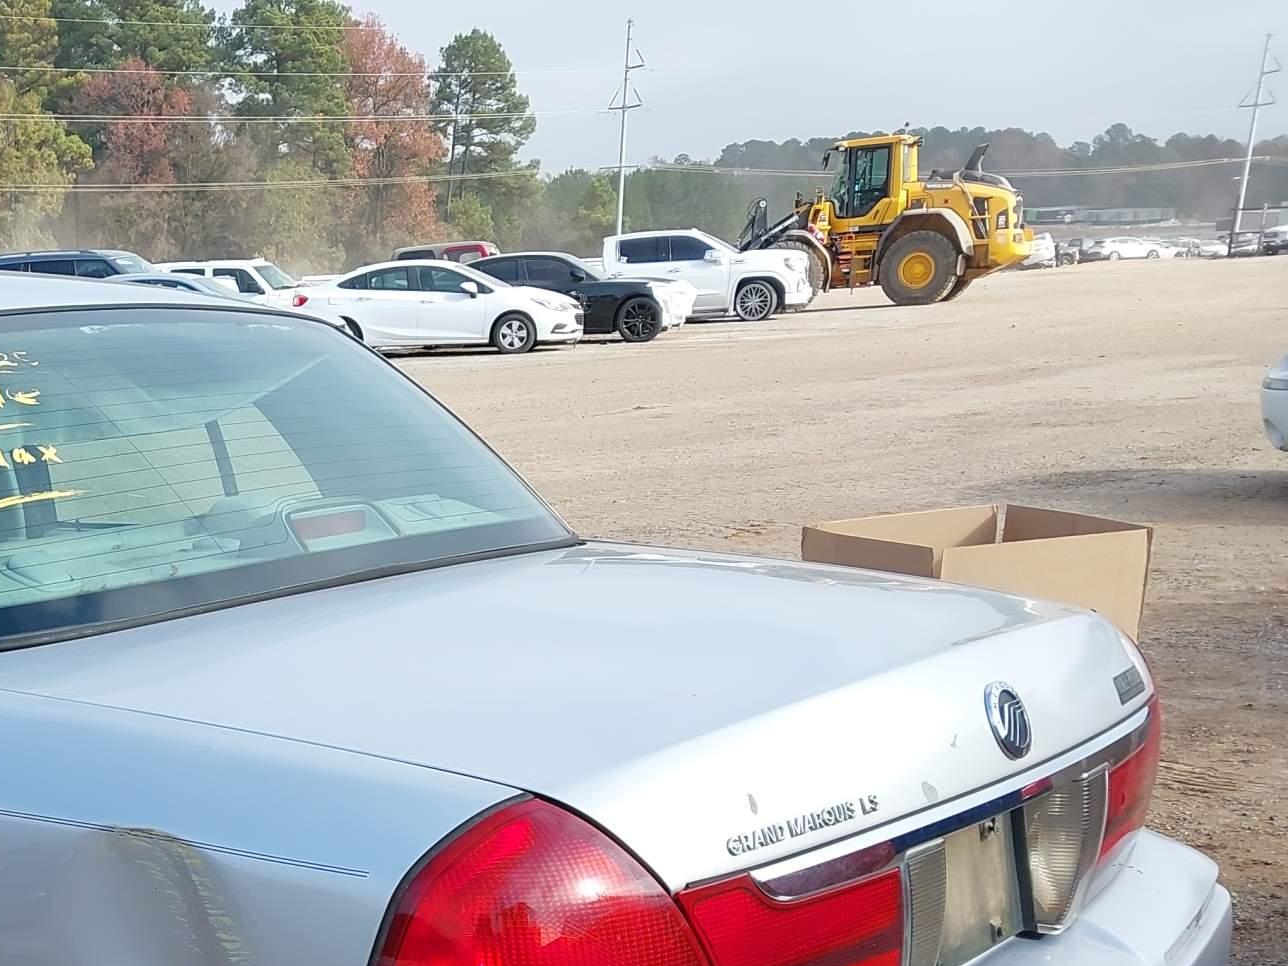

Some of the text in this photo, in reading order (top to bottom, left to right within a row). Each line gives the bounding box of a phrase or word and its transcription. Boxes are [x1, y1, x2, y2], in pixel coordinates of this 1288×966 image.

[726, 794, 880, 856] GRAND MARQUIS LS
